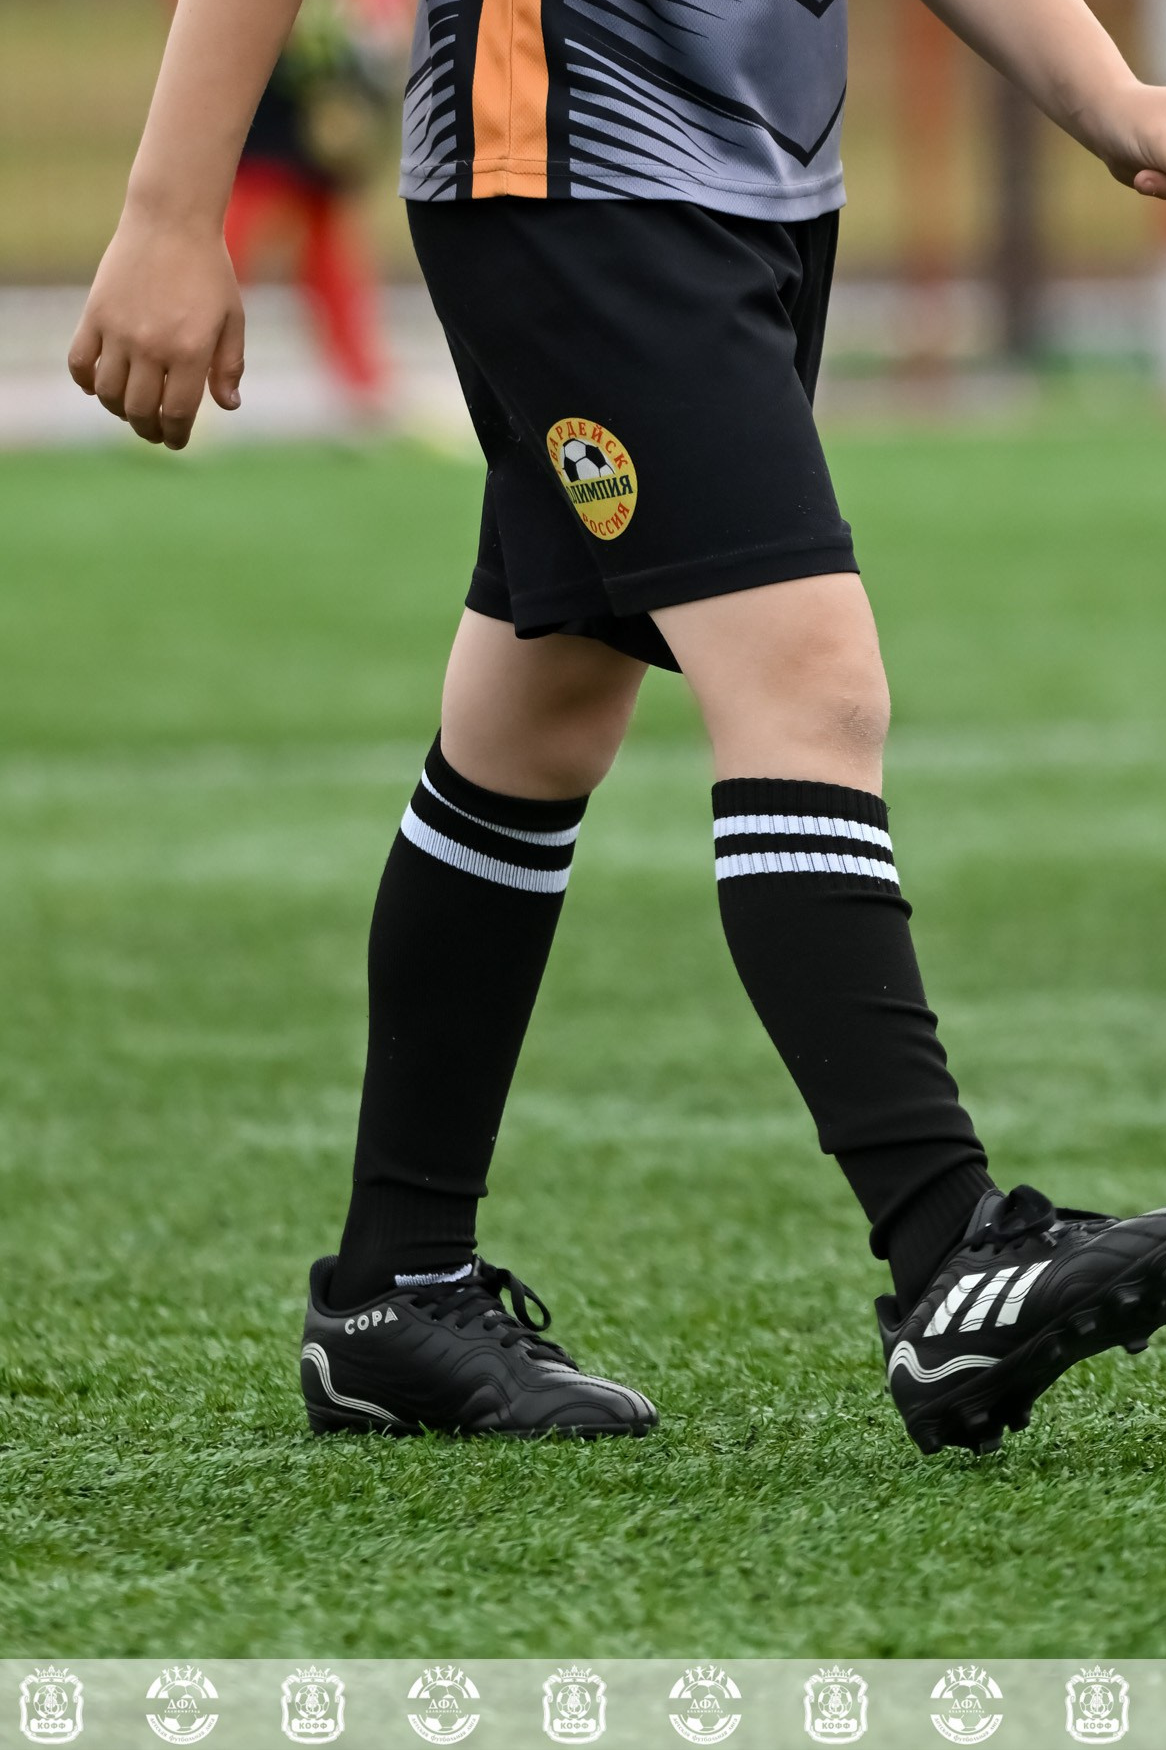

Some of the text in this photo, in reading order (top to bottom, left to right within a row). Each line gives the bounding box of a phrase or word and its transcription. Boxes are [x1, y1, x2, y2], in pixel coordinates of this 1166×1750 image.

[549, 420, 628, 477] ВАРДЕЙСК
[582, 502, 631, 537] РОССИЯ
[344, 1307, 399, 1335] COPA
